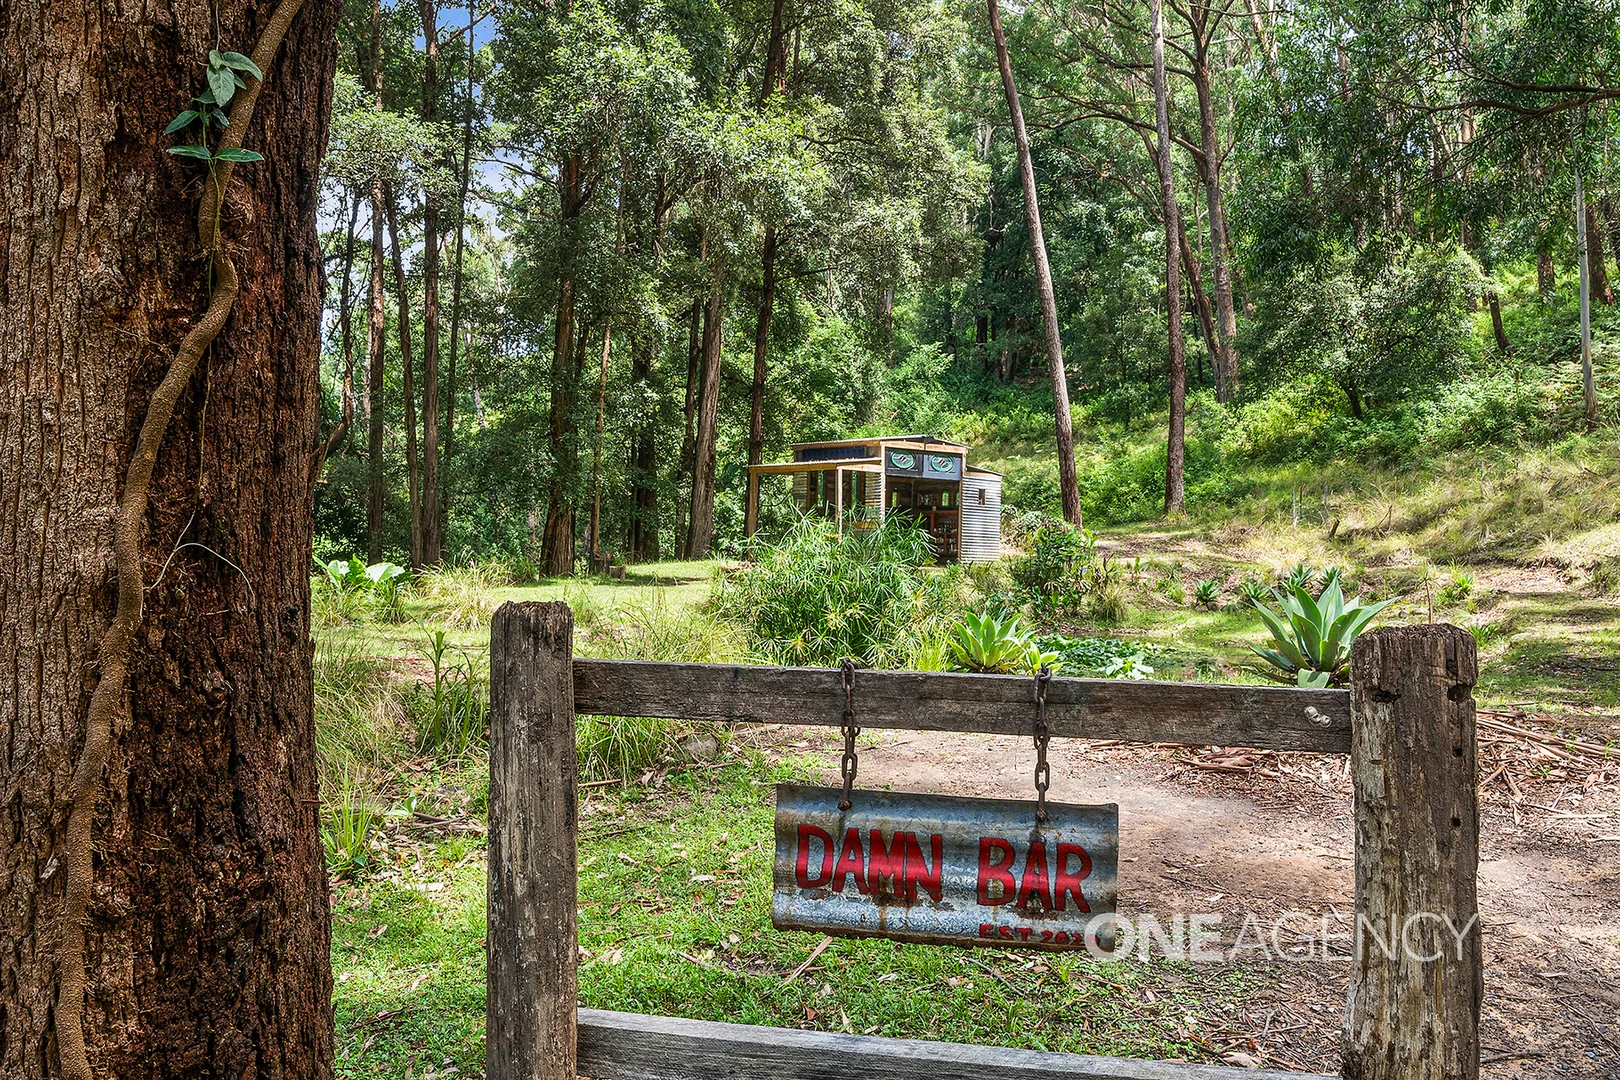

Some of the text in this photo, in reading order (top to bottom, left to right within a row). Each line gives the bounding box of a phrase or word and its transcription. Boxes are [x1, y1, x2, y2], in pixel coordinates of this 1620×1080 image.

[795, 825, 1092, 913] DAMN BAR
[979, 923, 1032, 941] EST
